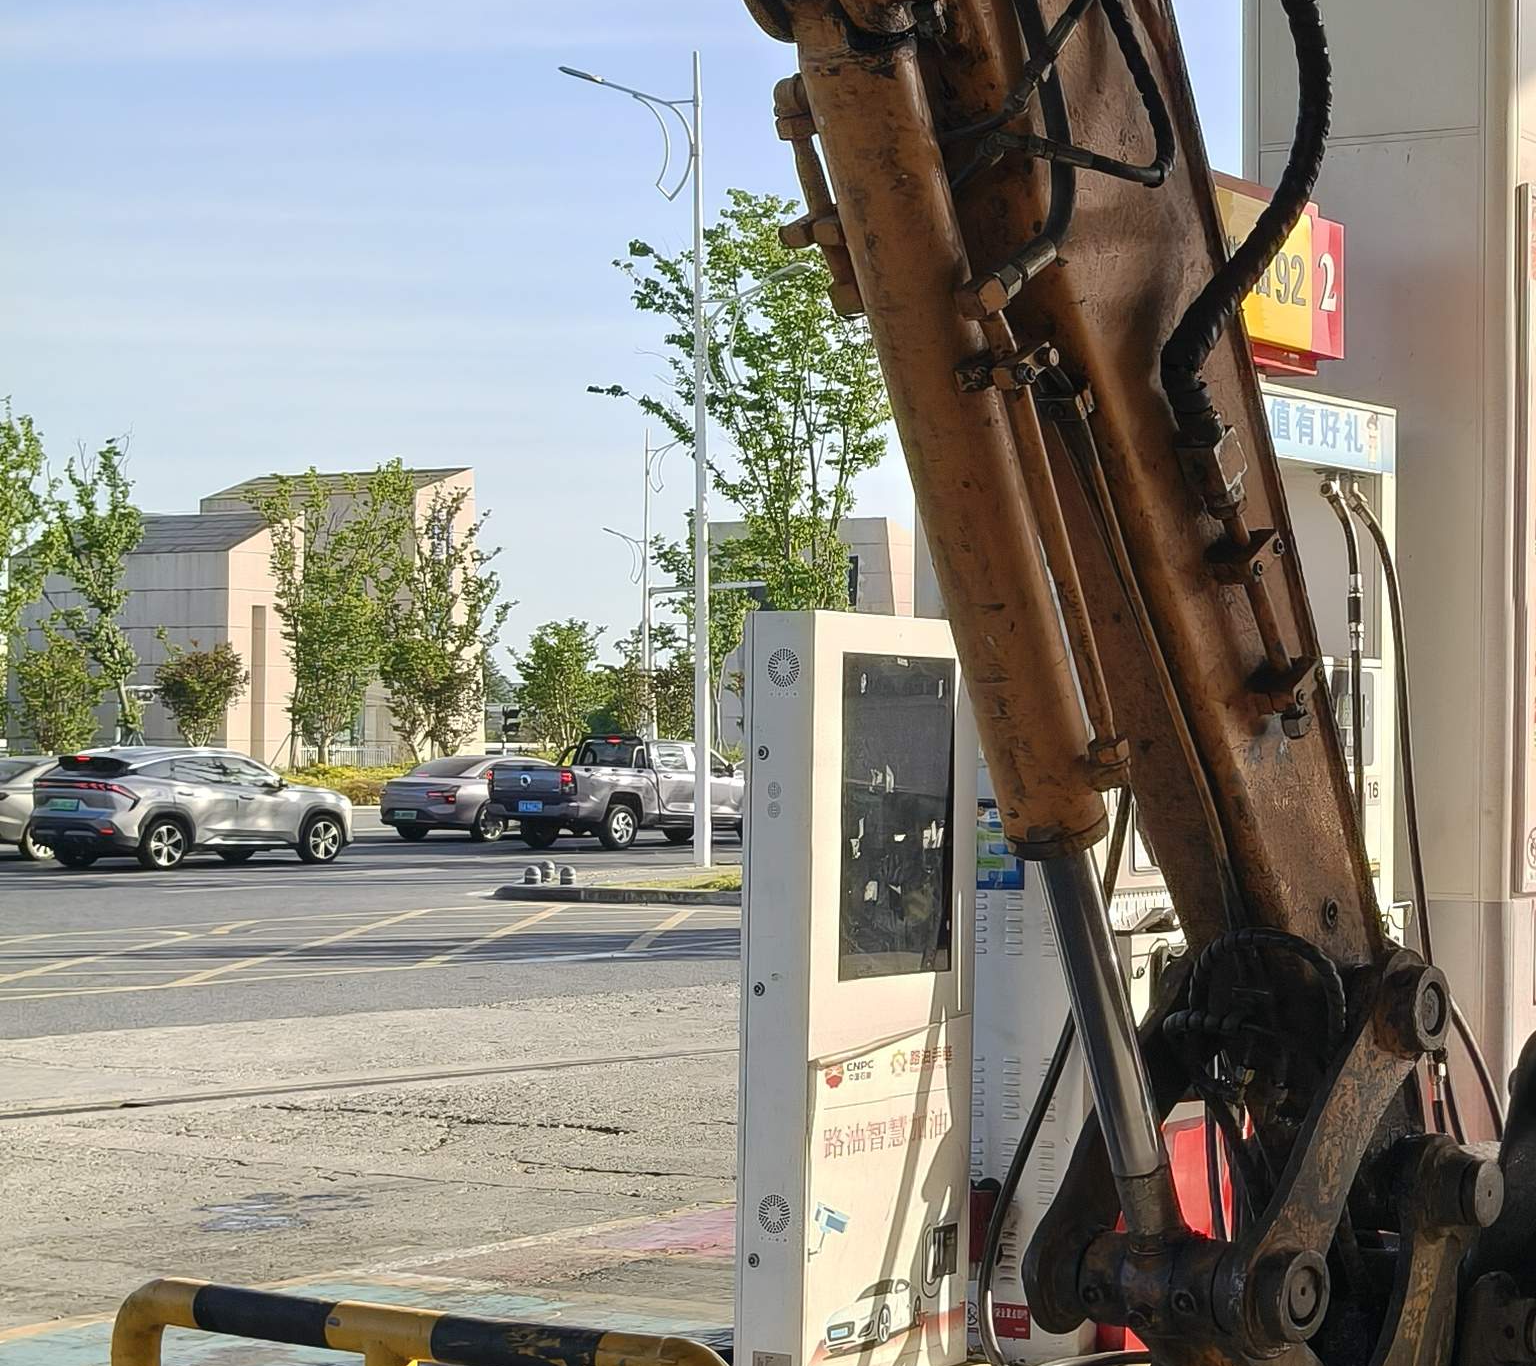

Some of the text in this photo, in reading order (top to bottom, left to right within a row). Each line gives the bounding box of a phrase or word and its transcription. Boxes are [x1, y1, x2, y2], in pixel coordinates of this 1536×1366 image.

[1318, 251, 1337, 313] 2
[1271, 398, 1364, 454] 值有好礼
[1367, 781, 1379, 800] 16
[846, 1059, 874, 1072] CNPC
[822, 1107, 948, 1160] 路油智慧加油
